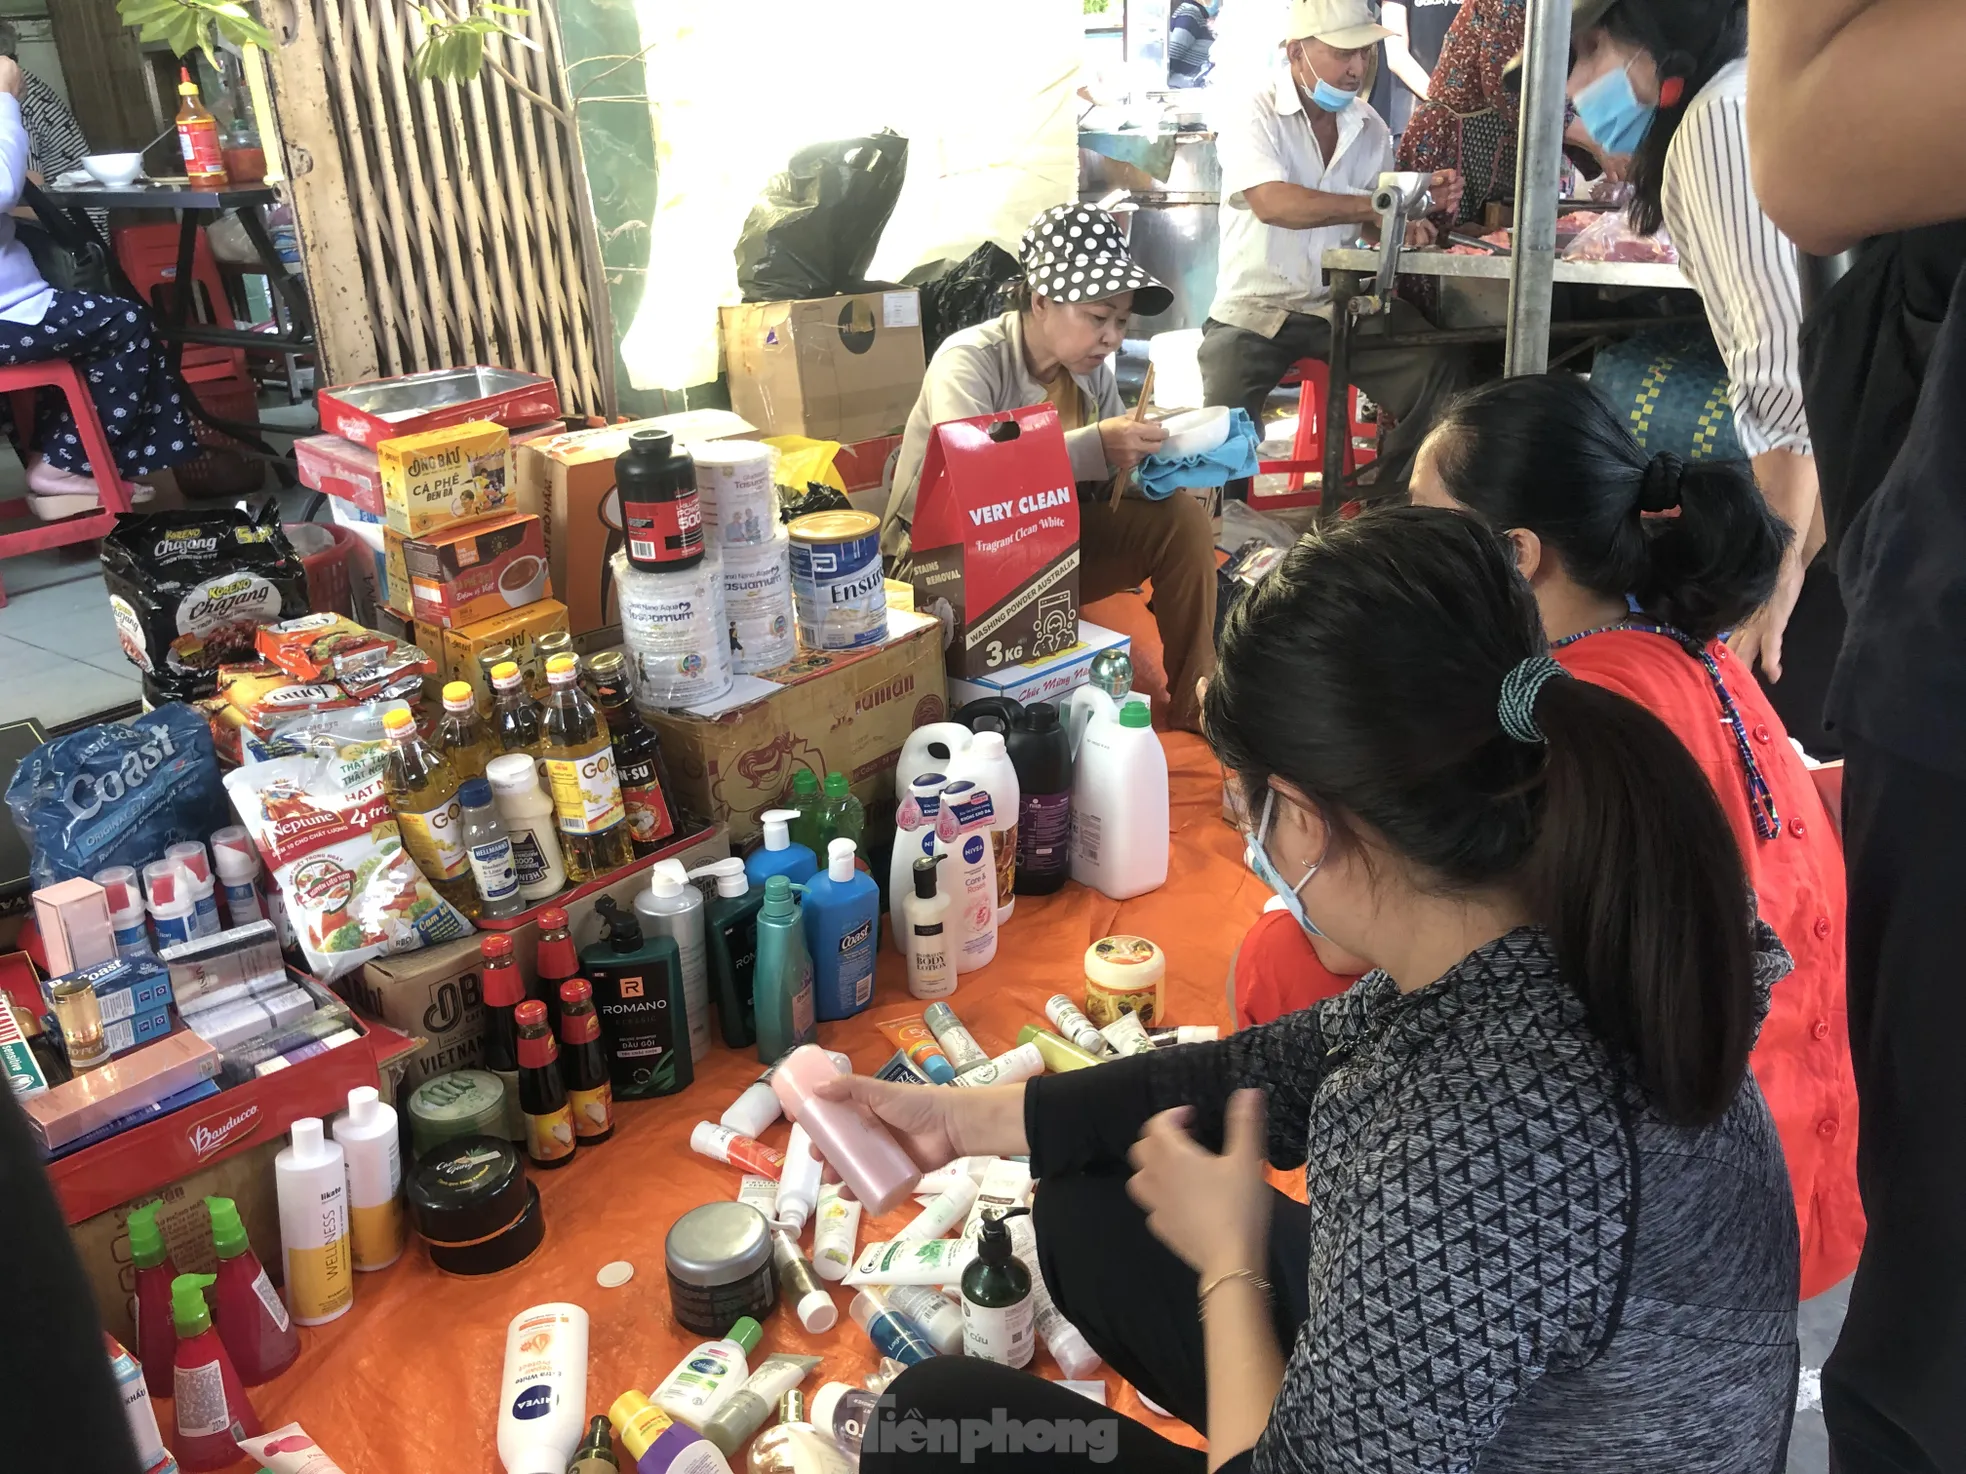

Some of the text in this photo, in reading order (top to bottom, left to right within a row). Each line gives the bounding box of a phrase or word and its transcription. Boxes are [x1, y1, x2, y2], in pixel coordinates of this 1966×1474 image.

[969, 486, 1071, 526] VERY CLEAN
[165, 528, 202, 540] KORENO
[975, 516, 1065, 553] Fragrant Clean White
[154, 537, 217, 557] Chajang
[913, 561, 939, 576] STAINS
[926, 569, 961, 586] REMOVAL
[208, 578, 252, 600] KORENO
[189, 586, 270, 621] Chajang
[970, 558, 1075, 643] WASHING POWDER AUSTRALIA
[986, 641, 1023, 667] 3 KG
[63, 724, 176, 820] Coast
[273, 812, 335, 837] Neptune
[350, 808, 368, 828] 4
[294, 836, 309, 846] CHO
[965, 844, 983, 856] NIVEA
[965, 876, 981, 887] Care
[841, 923, 870, 950] Coast
[916, 955, 944, 966] BODY
[917, 963, 946, 971] LOTION
[624, 980, 639, 994] R
[603, 999, 667, 1014] ROMANO
[3, 1045, 22, 1071] sensitive
[189, 1105, 258, 1156] Bauducco
[321, 1186, 341, 1201] likato
[323, 1209, 338, 1282] WELLNESS
[515, 1371, 562, 1384] Etra White
[517, 1396, 552, 1410] NIVEA
